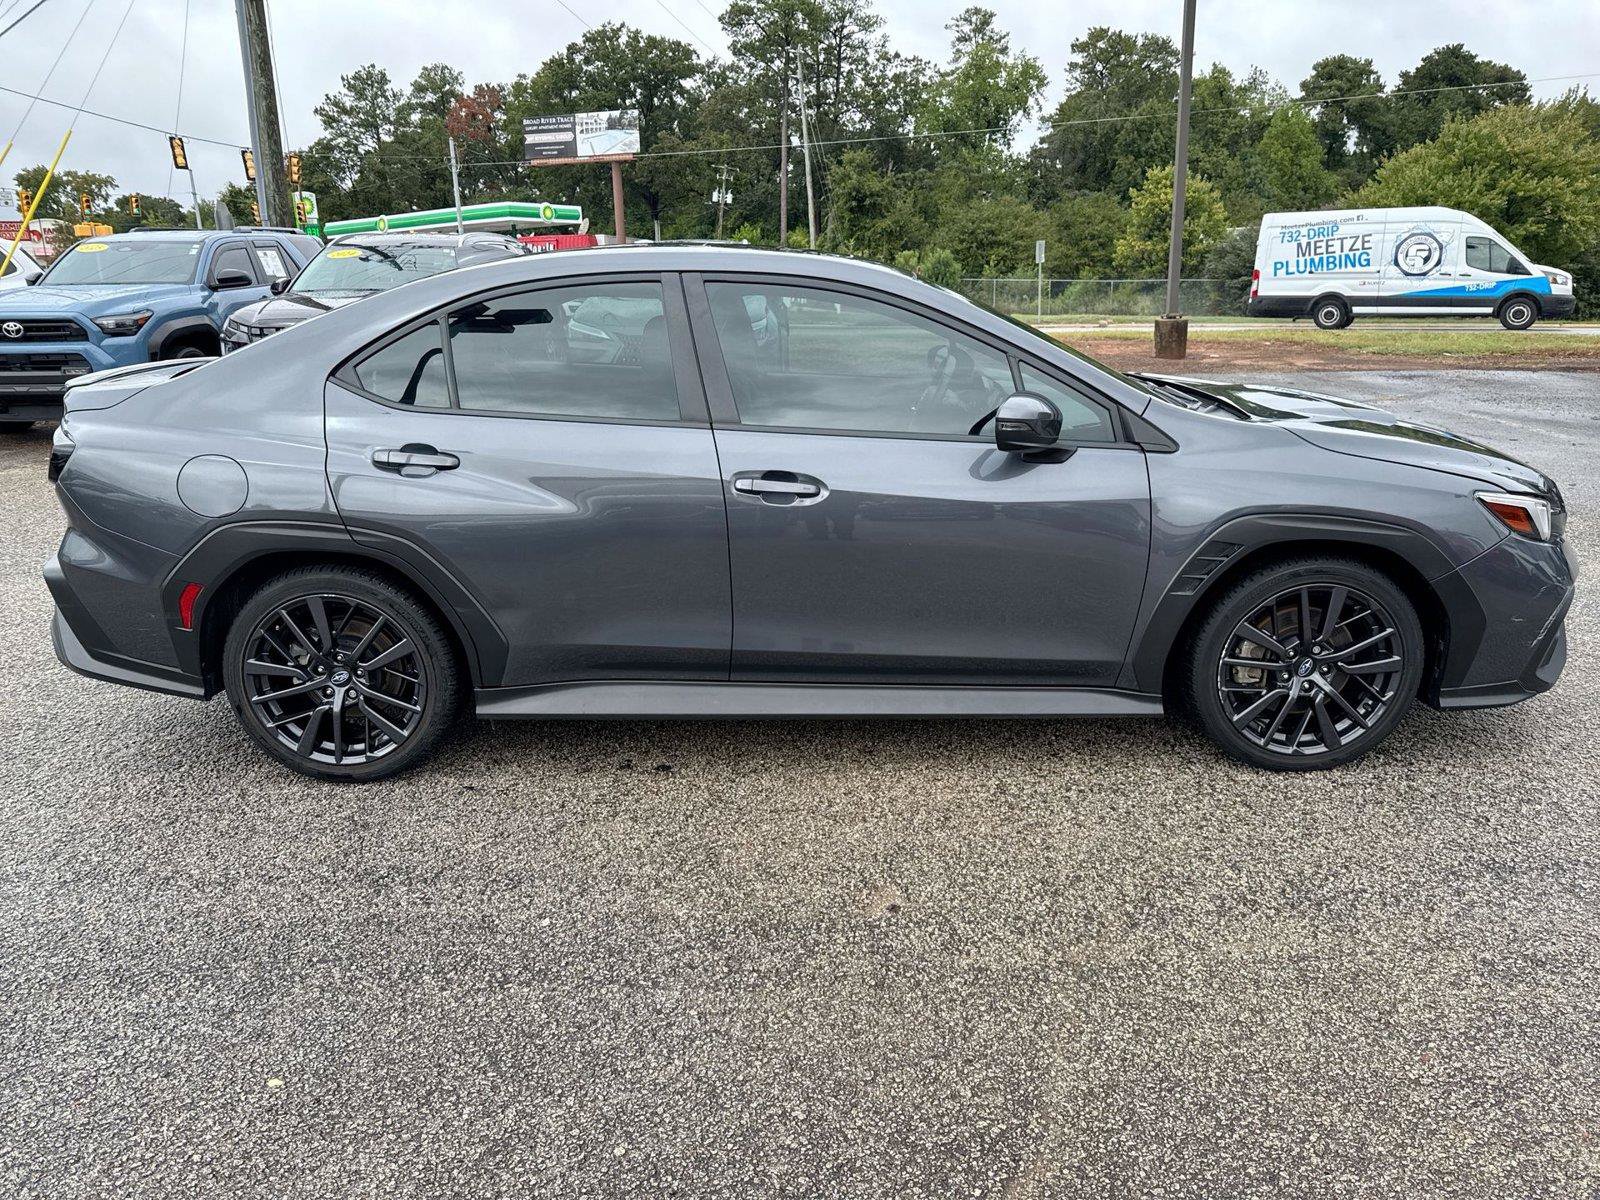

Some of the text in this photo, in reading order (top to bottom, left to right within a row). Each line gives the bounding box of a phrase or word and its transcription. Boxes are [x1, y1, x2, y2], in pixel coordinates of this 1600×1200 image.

[1280, 224, 1339, 243] 732-DRIP
[1296, 233, 1372, 258] MEETZE
[1273, 251, 1371, 277] PLUMBING
[1465, 281, 1497, 292] 732-DRIP
